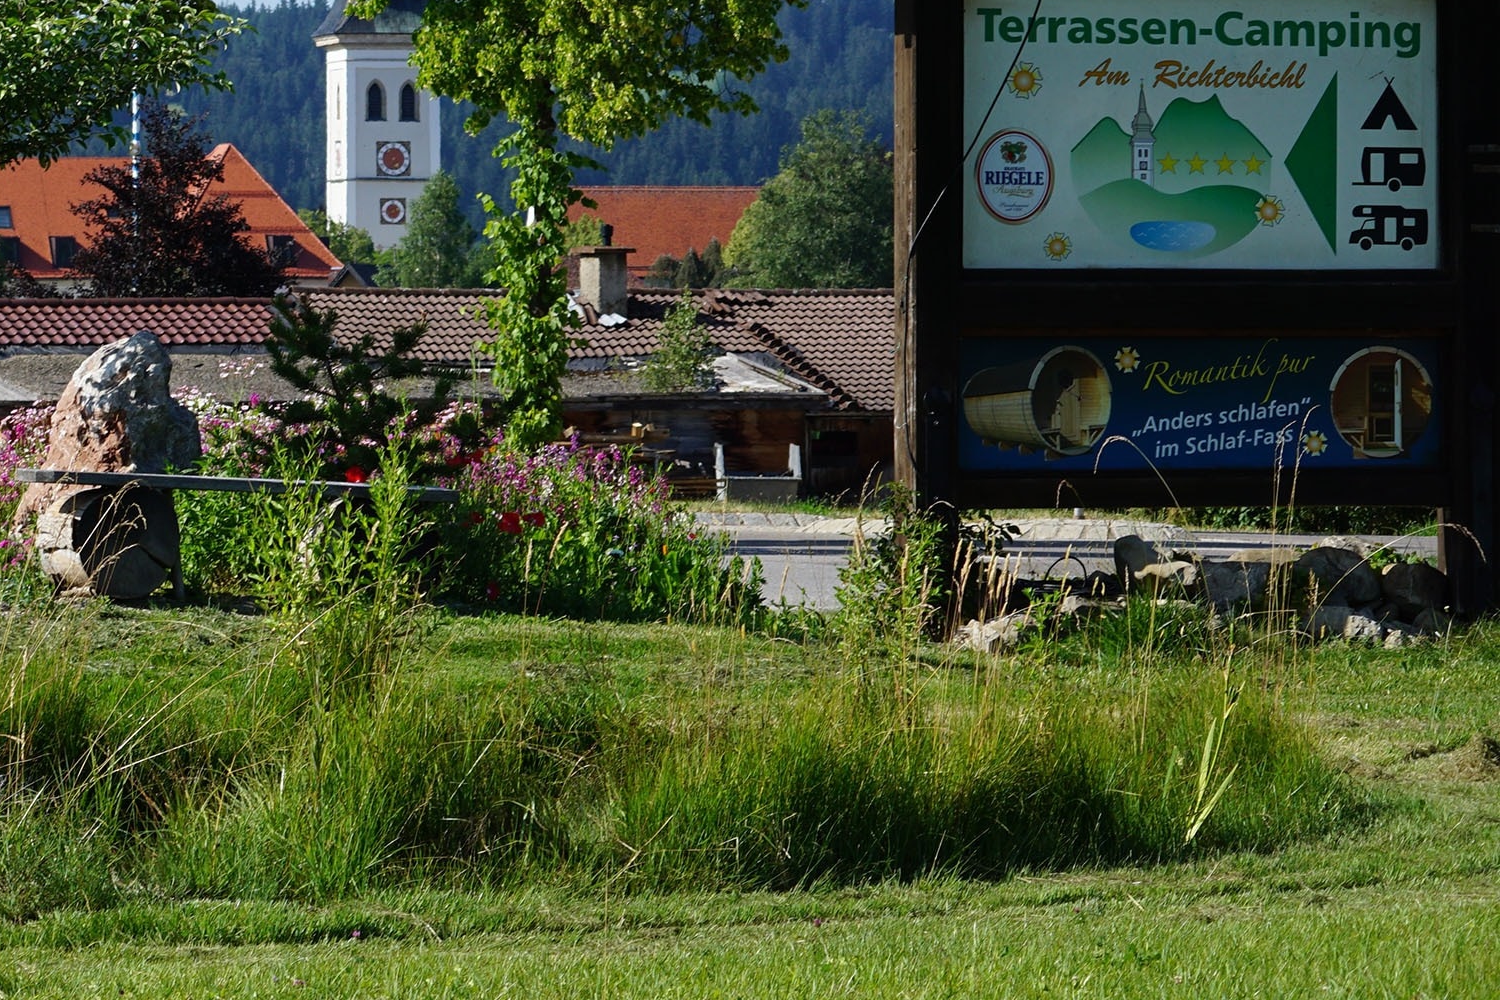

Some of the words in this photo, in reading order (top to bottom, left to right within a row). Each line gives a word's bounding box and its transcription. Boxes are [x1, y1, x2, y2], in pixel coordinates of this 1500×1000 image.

[976, 7, 1422, 58] Terrassen-Camping
[1078, 57, 1131, 88] Am
[1152, 58, 1308, 89] Richterbichl
[984, 170, 1045, 186] RIEGELE
[1142, 337, 1280, 395] Romantik
[1260, 353, 1316, 404] pur
[1155, 440, 1179, 459] im
[1185, 427, 1294, 455] Schlaf-Fass
